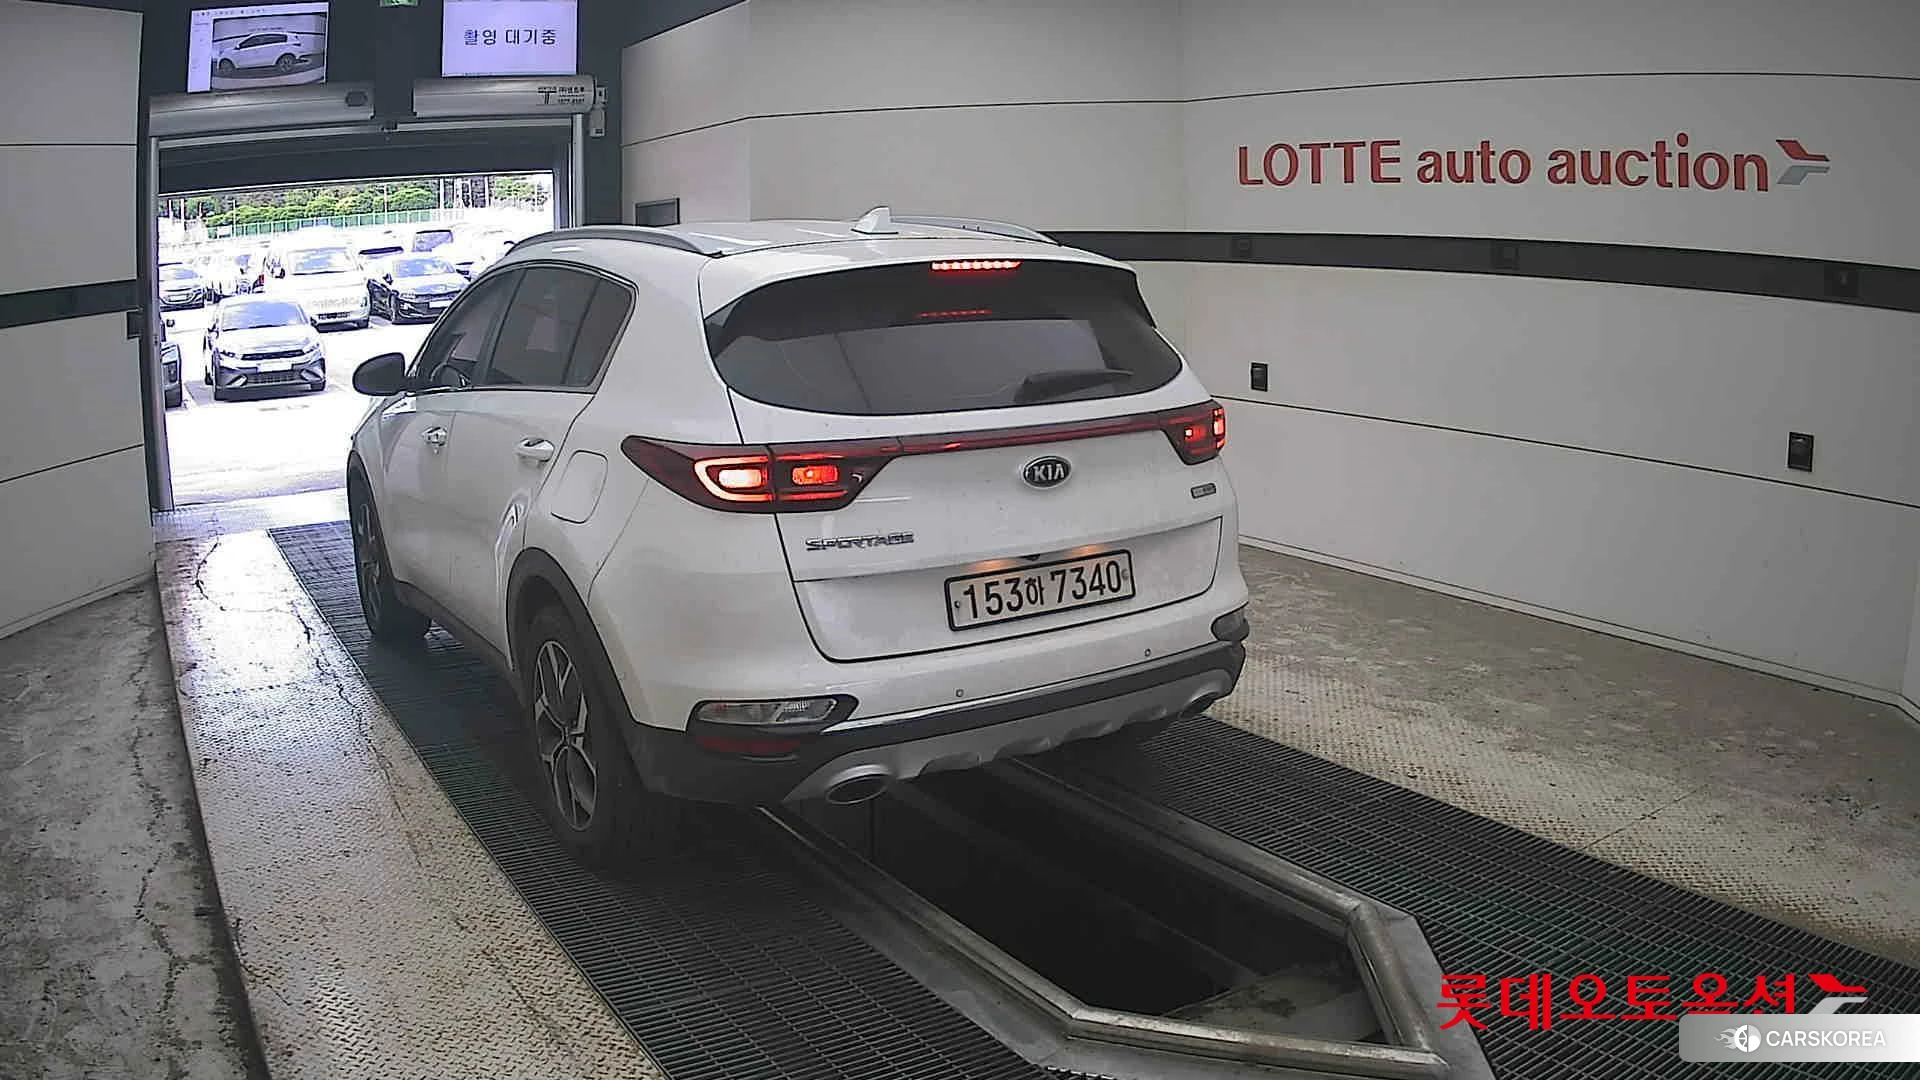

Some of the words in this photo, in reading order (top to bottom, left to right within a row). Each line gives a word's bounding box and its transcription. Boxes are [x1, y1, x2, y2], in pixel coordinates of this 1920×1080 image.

[505, 29, 556, 46] 대기중
[1238, 139, 1401, 186] LOTTE
[1416, 140, 1532, 184] auto
[1547, 132, 1769, 192] auction
[1033, 463, 1065, 481] KIA
[963, 575, 1045, 619] 153하
[1050, 560, 1122, 604] 7340
